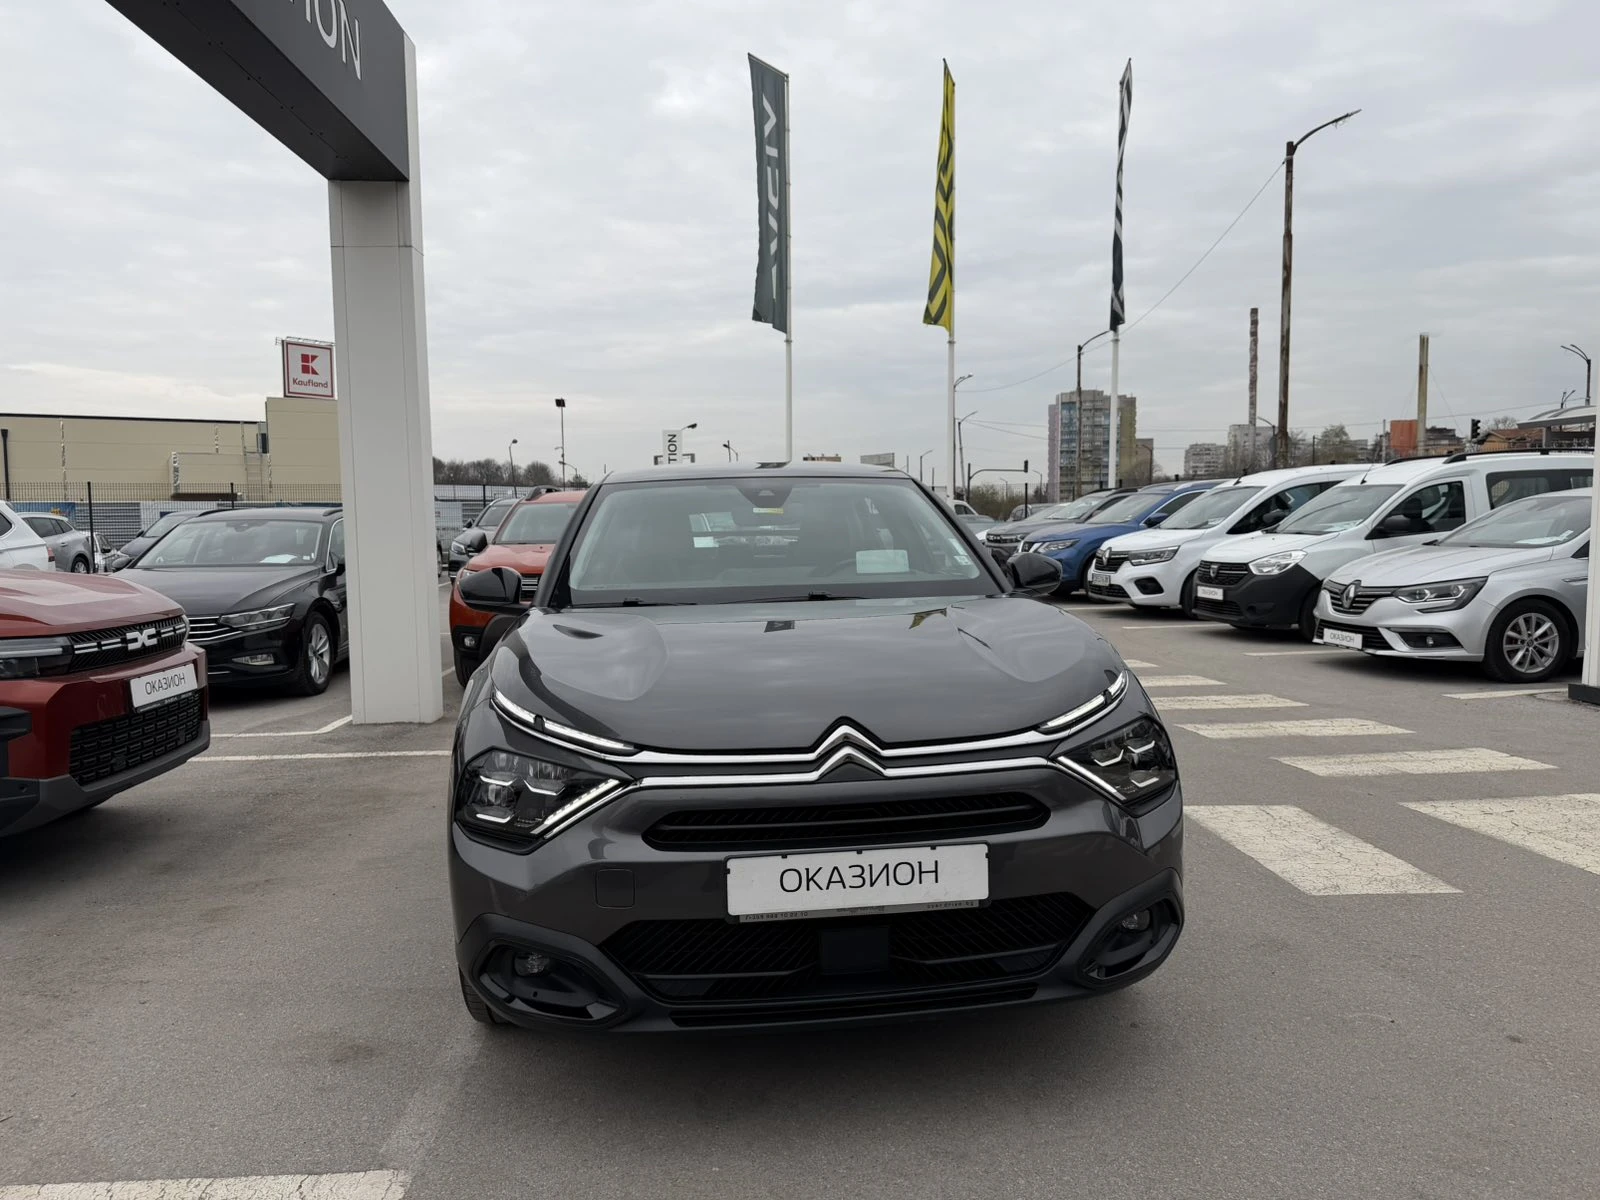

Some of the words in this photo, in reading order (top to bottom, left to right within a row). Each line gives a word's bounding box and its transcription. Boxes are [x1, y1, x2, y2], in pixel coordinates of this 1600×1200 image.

[292, 377, 329, 389] Kaufland
[144, 671, 187, 696] ОКАЗИОН
[779, 859, 940, 893] ОКАЗИОН
